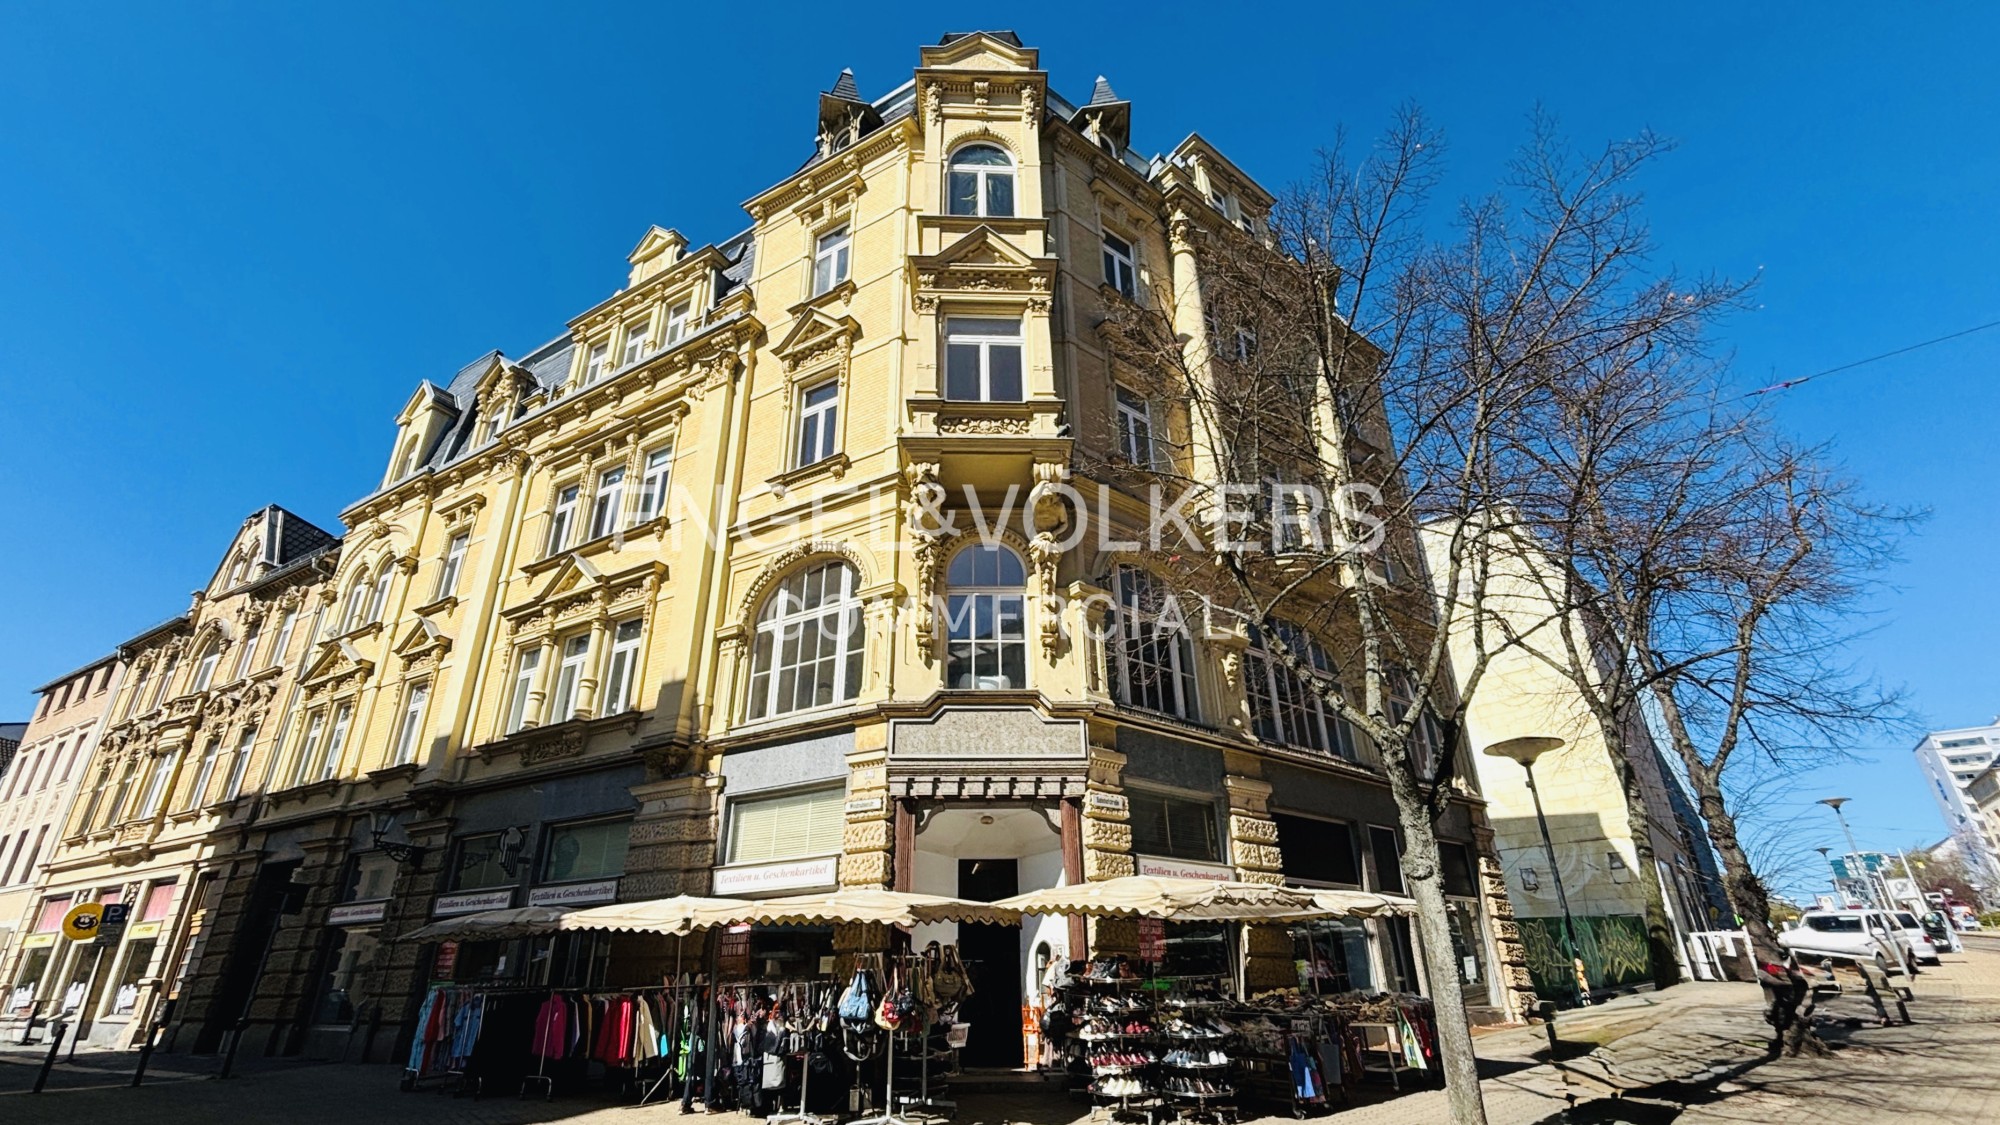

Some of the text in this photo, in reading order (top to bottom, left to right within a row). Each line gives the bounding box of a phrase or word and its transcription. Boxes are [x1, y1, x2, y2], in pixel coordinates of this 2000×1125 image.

[720, 874, 752, 884] Textilien
[763, 864, 828, 880] Geschenkartikel
[1143, 865, 1171, 876] Textilien
[1181, 869, 1230, 881] Geschenkartikel
[531, 892, 556, 902] Textilien
[562, 885, 614, 899] Geschenkartikel
[437, 900, 459, 910] Textilien
[465, 895, 510, 907] Geschenkartikel
[107, 906, 123, 921] P
[1138, 926, 1162, 935] VERAUF
